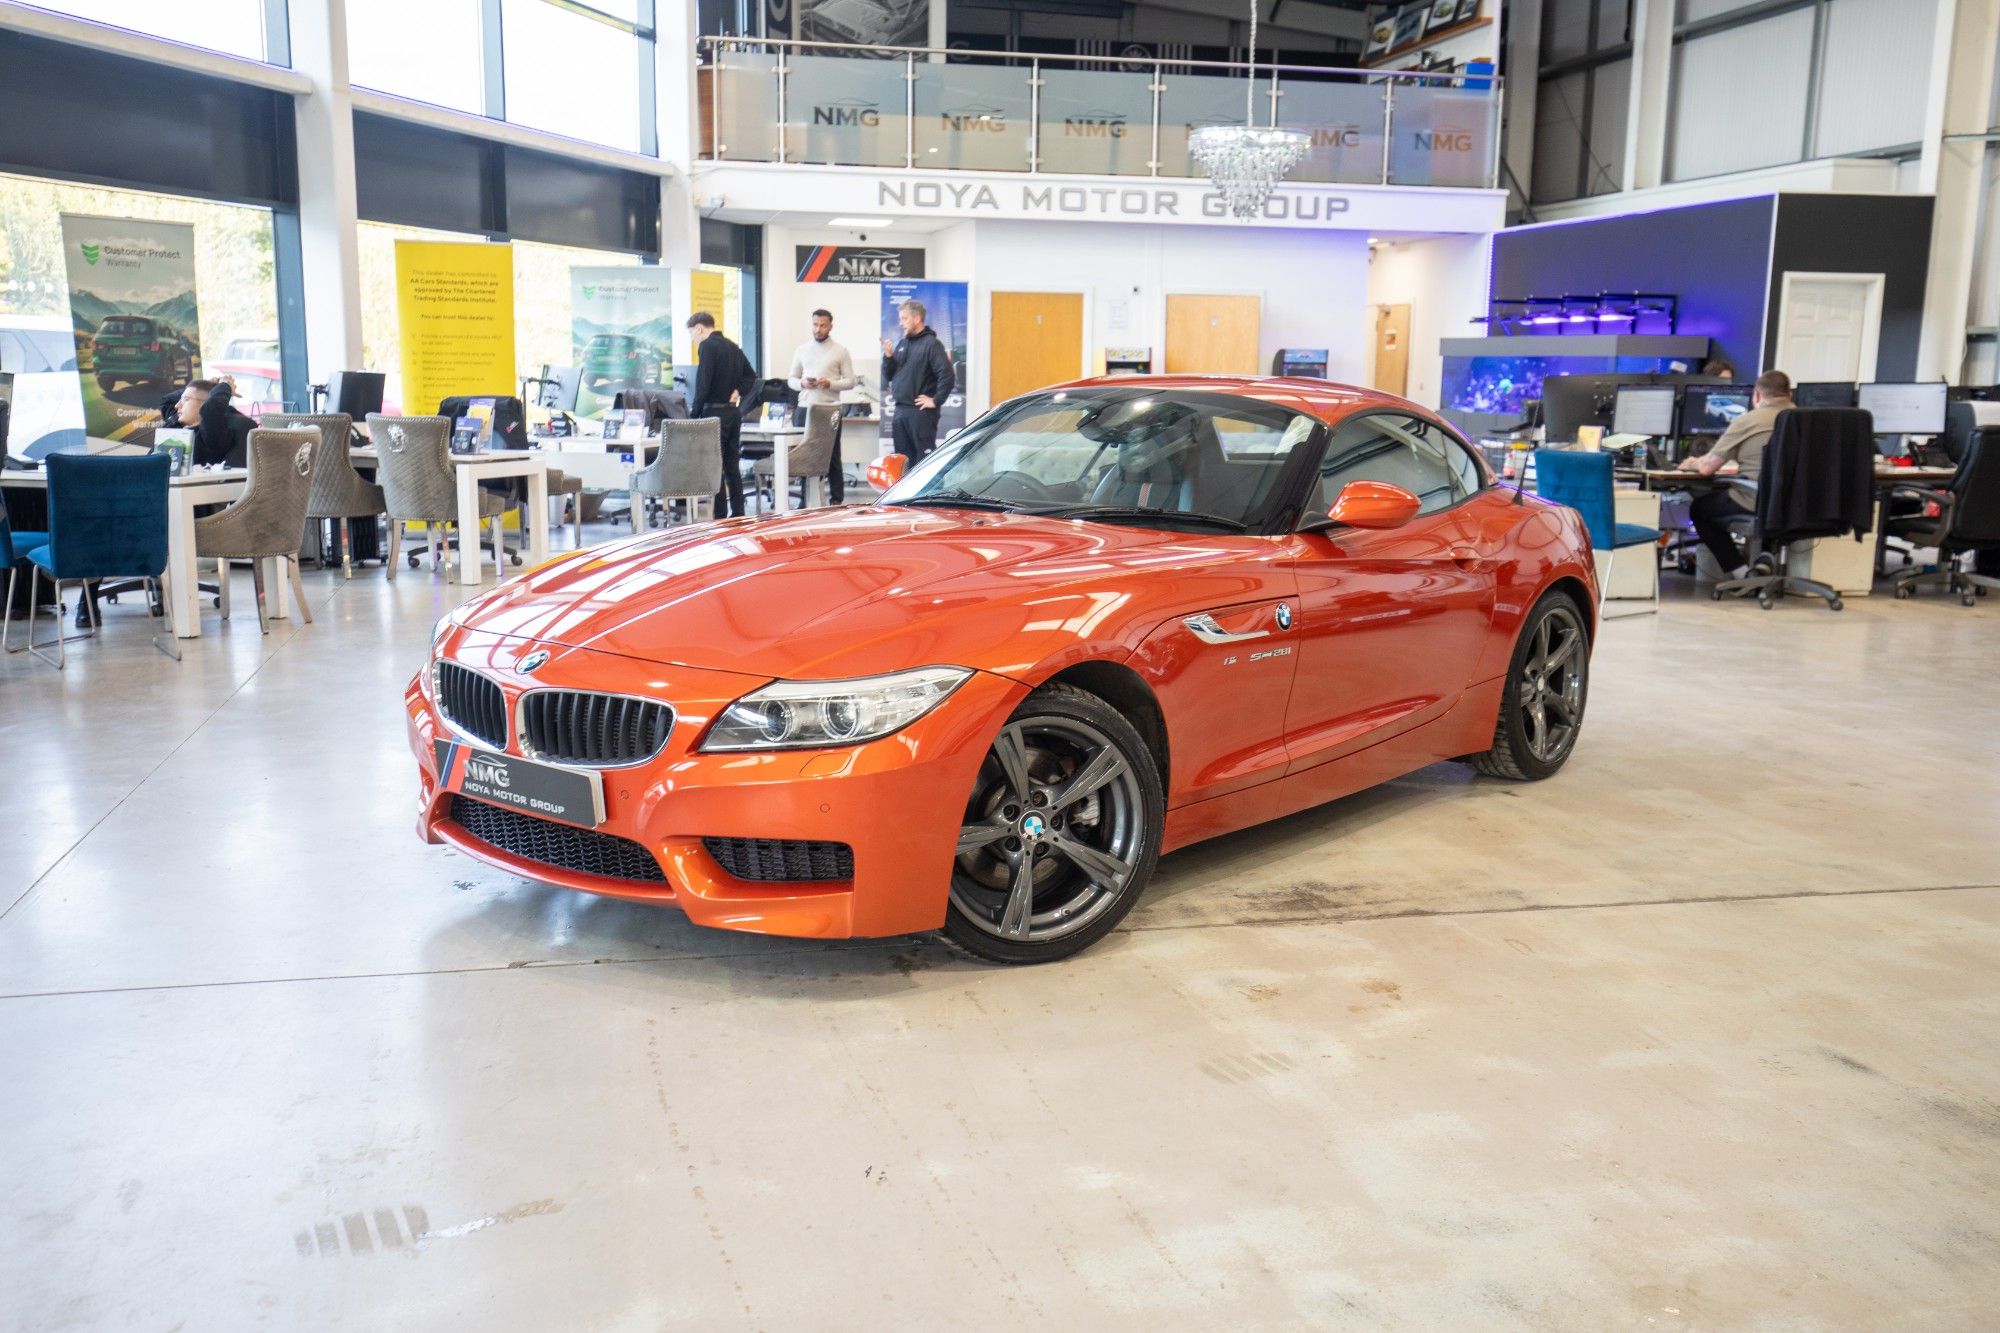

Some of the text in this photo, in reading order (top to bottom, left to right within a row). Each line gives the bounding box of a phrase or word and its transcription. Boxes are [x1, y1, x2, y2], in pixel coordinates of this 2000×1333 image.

[814, 106, 880, 128] NMG
[942, 113, 1006, 132] NMG
[1064, 118, 1128, 138] NMG
[1414, 132, 1473, 152] NMG
[878, 181, 1350, 221] NOYA MOTOR GOUP
[104, 246, 180, 259] Customer Protect
[838, 257, 902, 277] NMG
[463, 759, 511, 788] NMG
[464, 781, 565, 814] NOYA MOTOR GROUP
